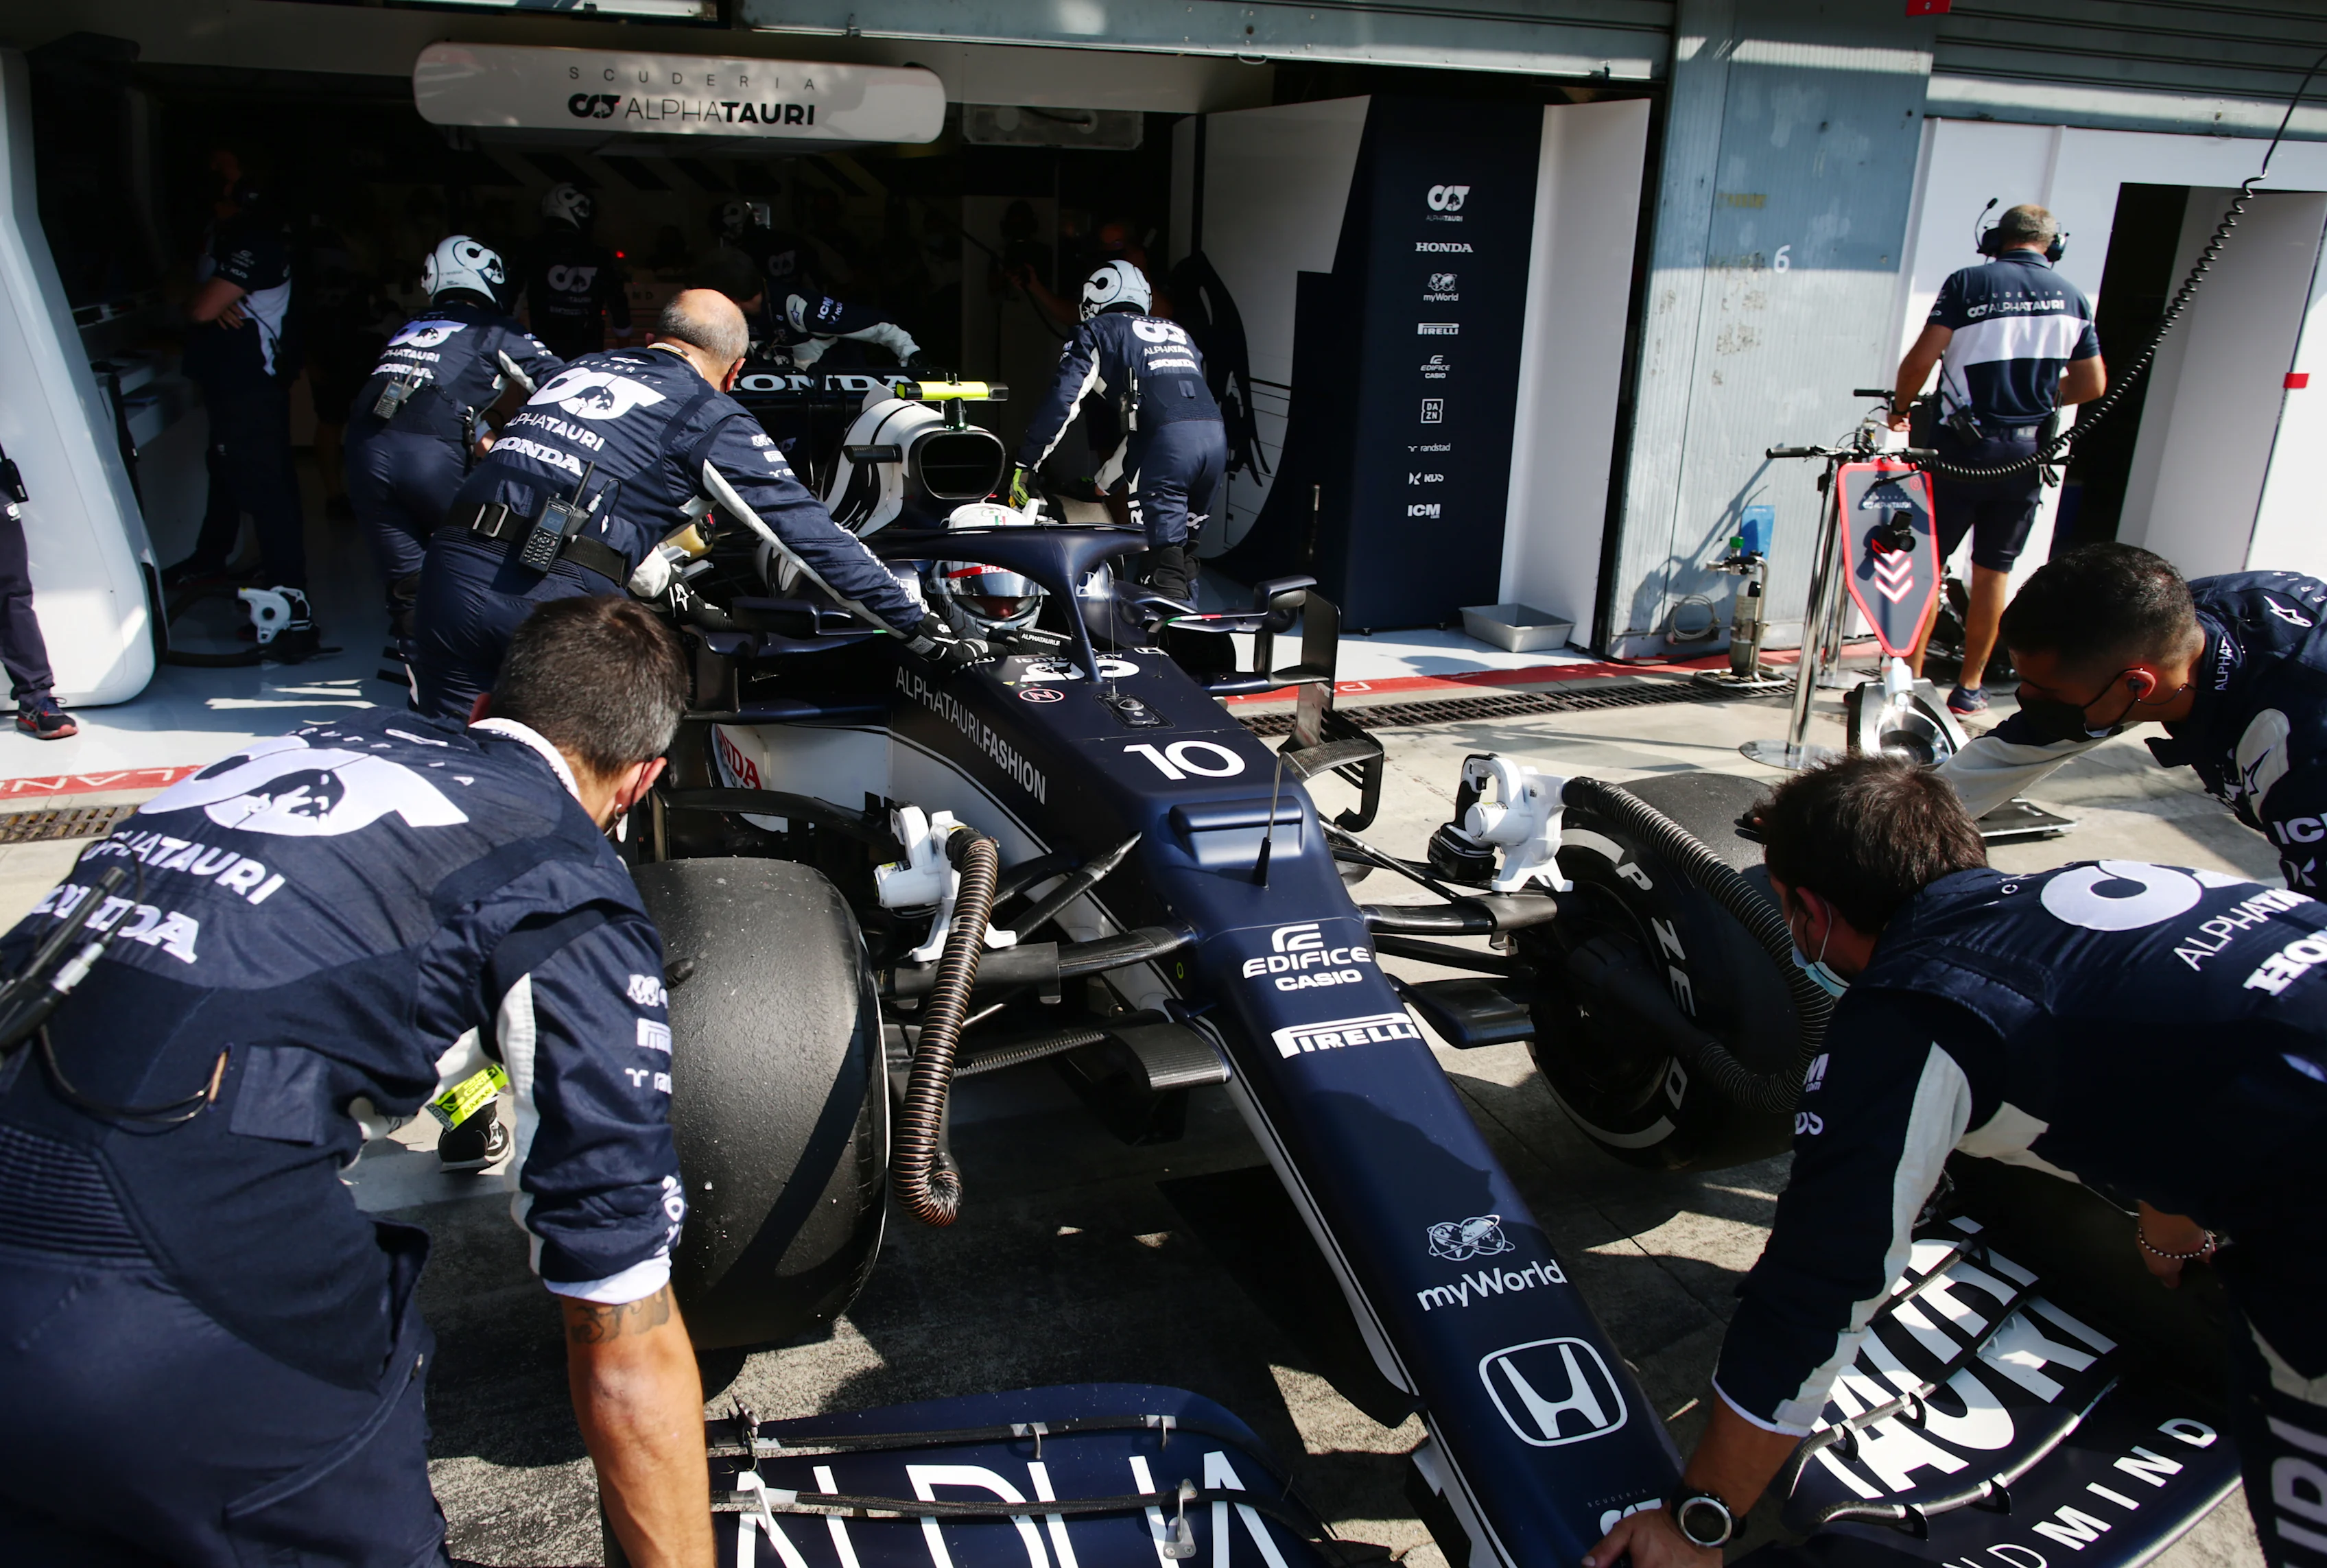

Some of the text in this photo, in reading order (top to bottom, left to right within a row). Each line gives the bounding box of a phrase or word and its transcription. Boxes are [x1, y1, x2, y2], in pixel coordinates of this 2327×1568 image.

[569, 65, 815, 91] SCUDERIA
[624, 97, 815, 126] ALPHATAURI
[1415, 242, 1474, 252] HONDA
[1774, 245, 1791, 274] 6
[816, 296, 834, 320] ICM
[1424, 293, 1459, 302] myWorld
[1988, 299, 2066, 313] ALPHATAURI
[1417, 323, 1460, 335] PIRELLI
[731, 374, 913, 391] ONDA
[1420, 443, 1451, 452] randstad
[1407, 503, 1441, 516] ICM
[1123, 740, 1246, 781] 10
[0, 769, 174, 793] LAN
[1615, 862, 1653, 891] P
[1242, 946, 1372, 979] EDIFICE
[1274, 969, 1363, 991] CASIO
[1271, 1012, 1421, 1059] PIRELLI
[428, 1103, 456, 1130] 2021
[1417, 1259, 1568, 1311] myWorld
[1587, 1488, 1649, 1508] SCUDERIA
